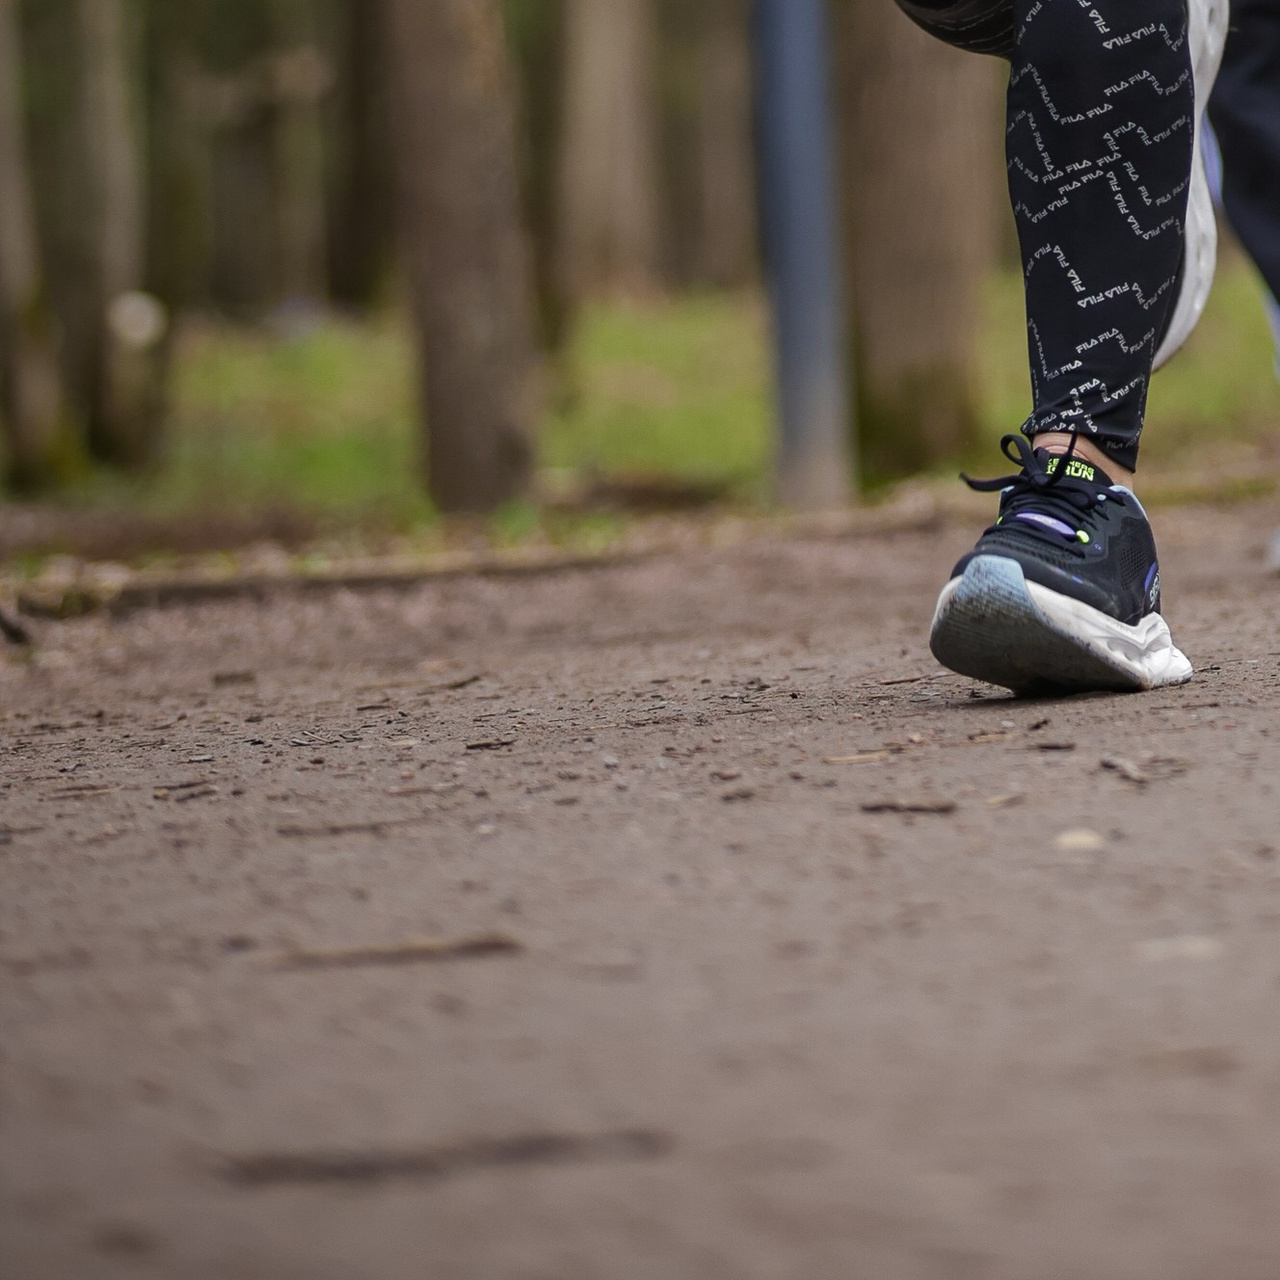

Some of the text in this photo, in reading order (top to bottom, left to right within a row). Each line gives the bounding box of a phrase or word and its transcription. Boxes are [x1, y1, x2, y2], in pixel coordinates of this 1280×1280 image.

[1089, 9, 1111, 34] FILA
[1102, 34, 1132, 50] FILA
[1103, 78, 1130, 97] FILA
[1086, 103, 1113, 118] FILA
[1065, 159, 1093, 174] FILA
[1052, 245, 1086, 292] FILA FILA
[1077, 282, 1130, 308] FILA FILA
[1075, 327, 1119, 354] FILA FILA
[1060, 359, 1083, 374] FILA
[1079, 378, 1101, 393] FILA
[1111, 385, 1131, 400] FILA
[1060, 407, 1084, 419] FILA
